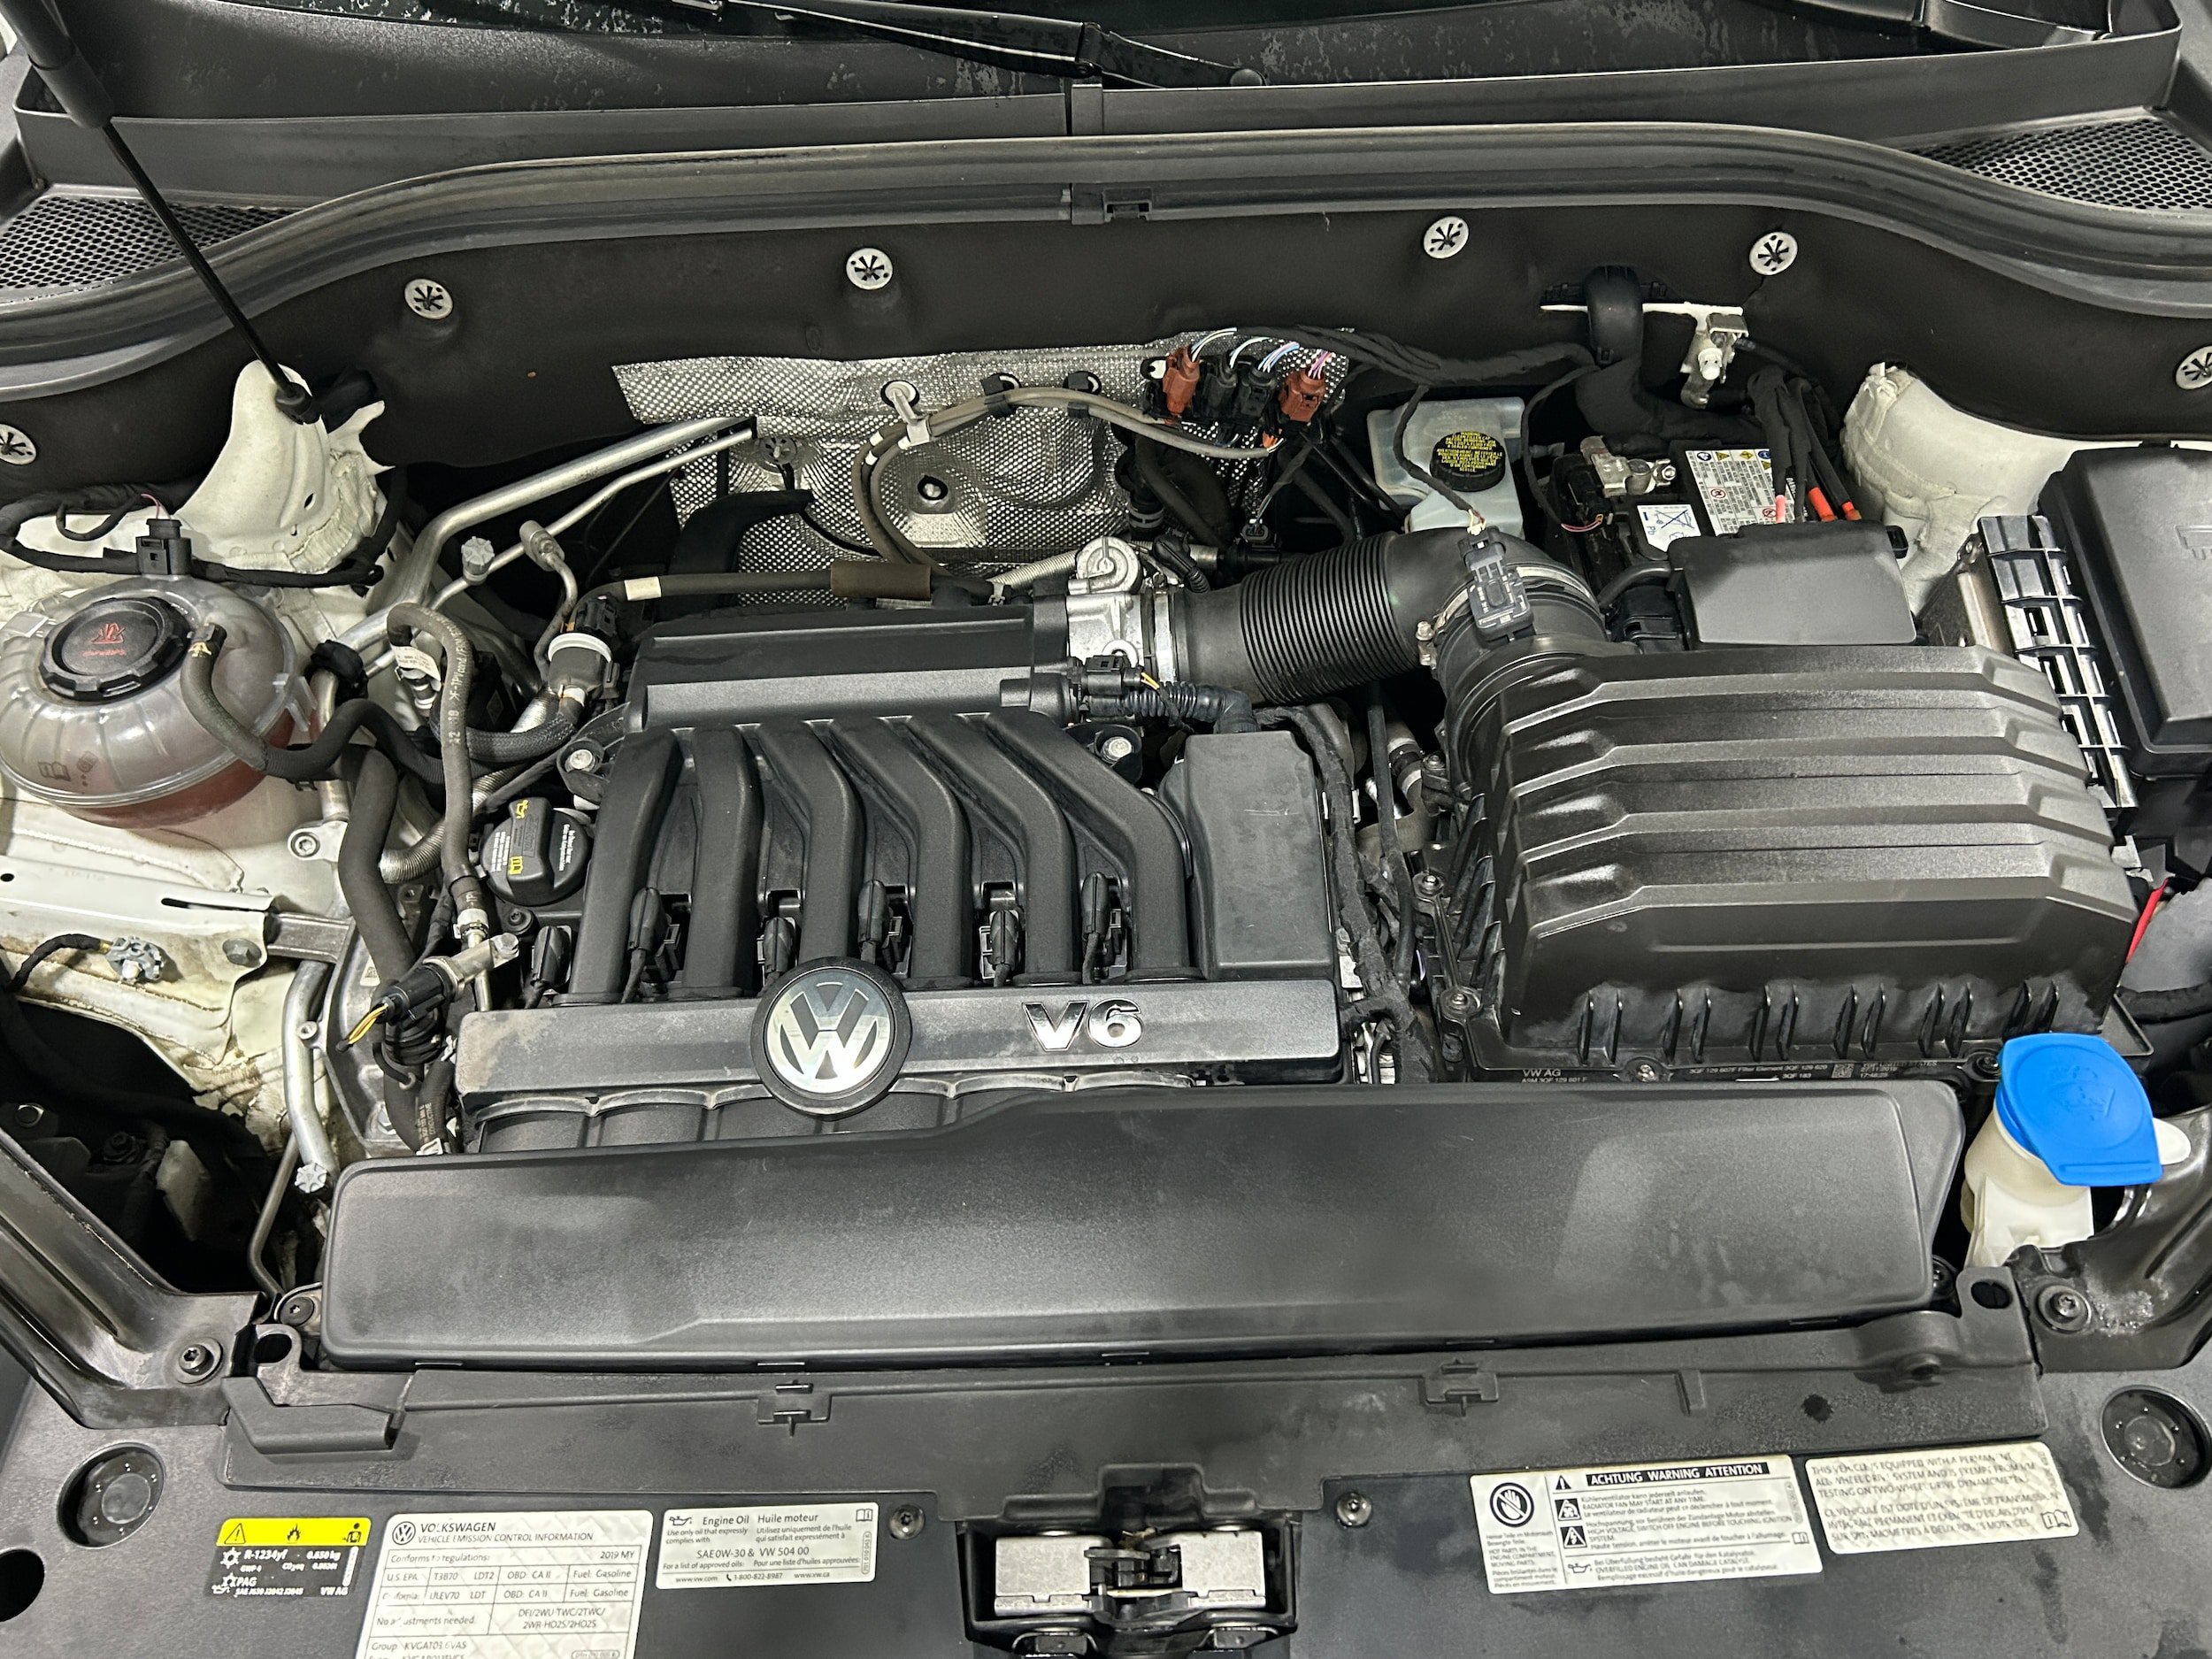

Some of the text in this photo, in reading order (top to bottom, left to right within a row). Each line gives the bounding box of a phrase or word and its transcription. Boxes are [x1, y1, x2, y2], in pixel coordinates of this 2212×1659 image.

[1022, 997, 1142, 1051] V6
[768, 967, 892, 1094] VW
[1544, 1068, 1561, 1077] AG
[1591, 1464, 1763, 1485] ACHTUNG WARNING ATTENTION
[703, 1515, 749, 1527] Engine Oil
[757, 1514, 782, 1523] Huile
[392, 1521, 416, 1545] VW
[495, 1533, 532, 1542] CONTROL
[534, 1532, 594, 1541] INFORMATION
[243, 1549, 288, 1562] R-1234yf
[748, 1548, 755, 1557] &
[759, 1548, 775, 1556] VW
[778, 1548, 795, 1556] 504
[797, 1547, 810, 1555] 00
[473, 1571, 495, 1580] LDT2
[236, 1577, 257, 1586] PAG
[320, 1586, 349, 1596] VW AG
[593, 1588, 629, 1597] Gasoline
